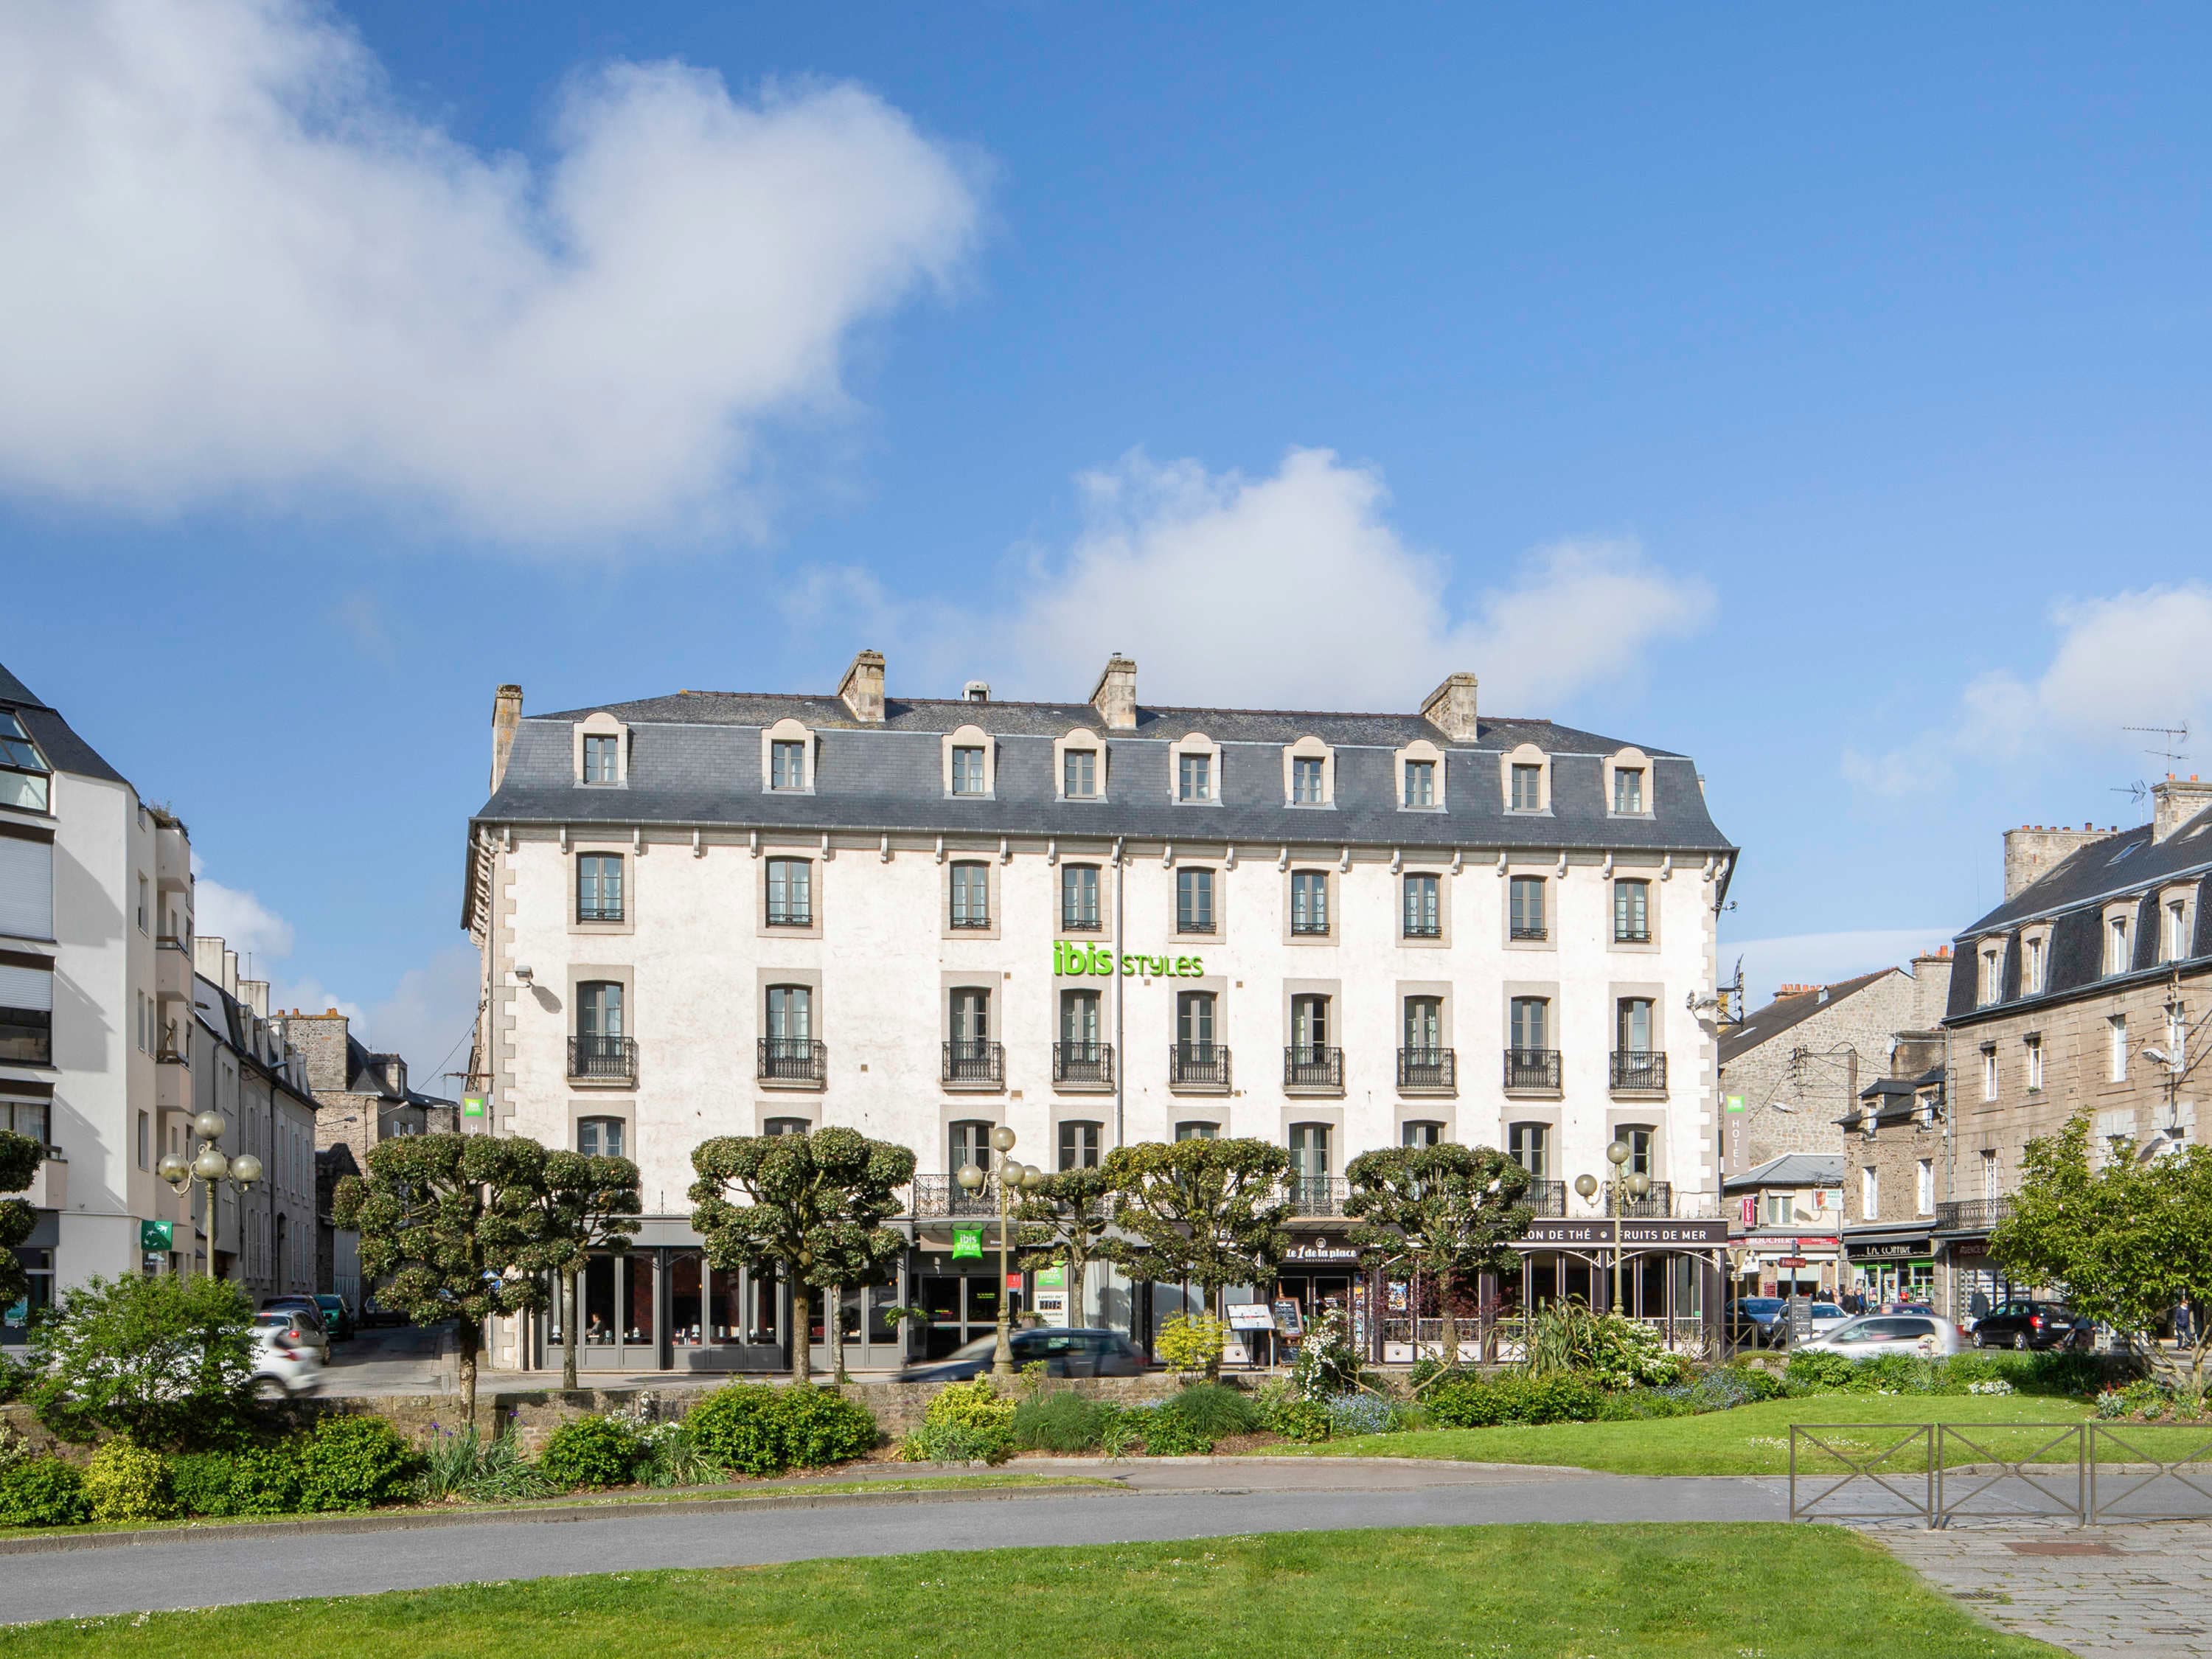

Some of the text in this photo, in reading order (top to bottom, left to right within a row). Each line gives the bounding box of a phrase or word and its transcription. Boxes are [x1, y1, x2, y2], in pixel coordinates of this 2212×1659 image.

[1054, 940, 1113, 975] ibis
[1732, 1120, 1740, 1168] HOTEL
[960, 1234, 977, 1244] ibis
[1549, 1230, 1564, 1239] DE
[1569, 1228, 1590, 1239] THÉ
[1663, 1231, 1677, 1239] DE
[1682, 1231, 1707, 1239] MER
[1298, 1245, 1305, 1259] 1
[1305, 1248, 1317, 1257] de
[1318, 1248, 1329, 1257] la
[1329, 1248, 1357, 1259] place
